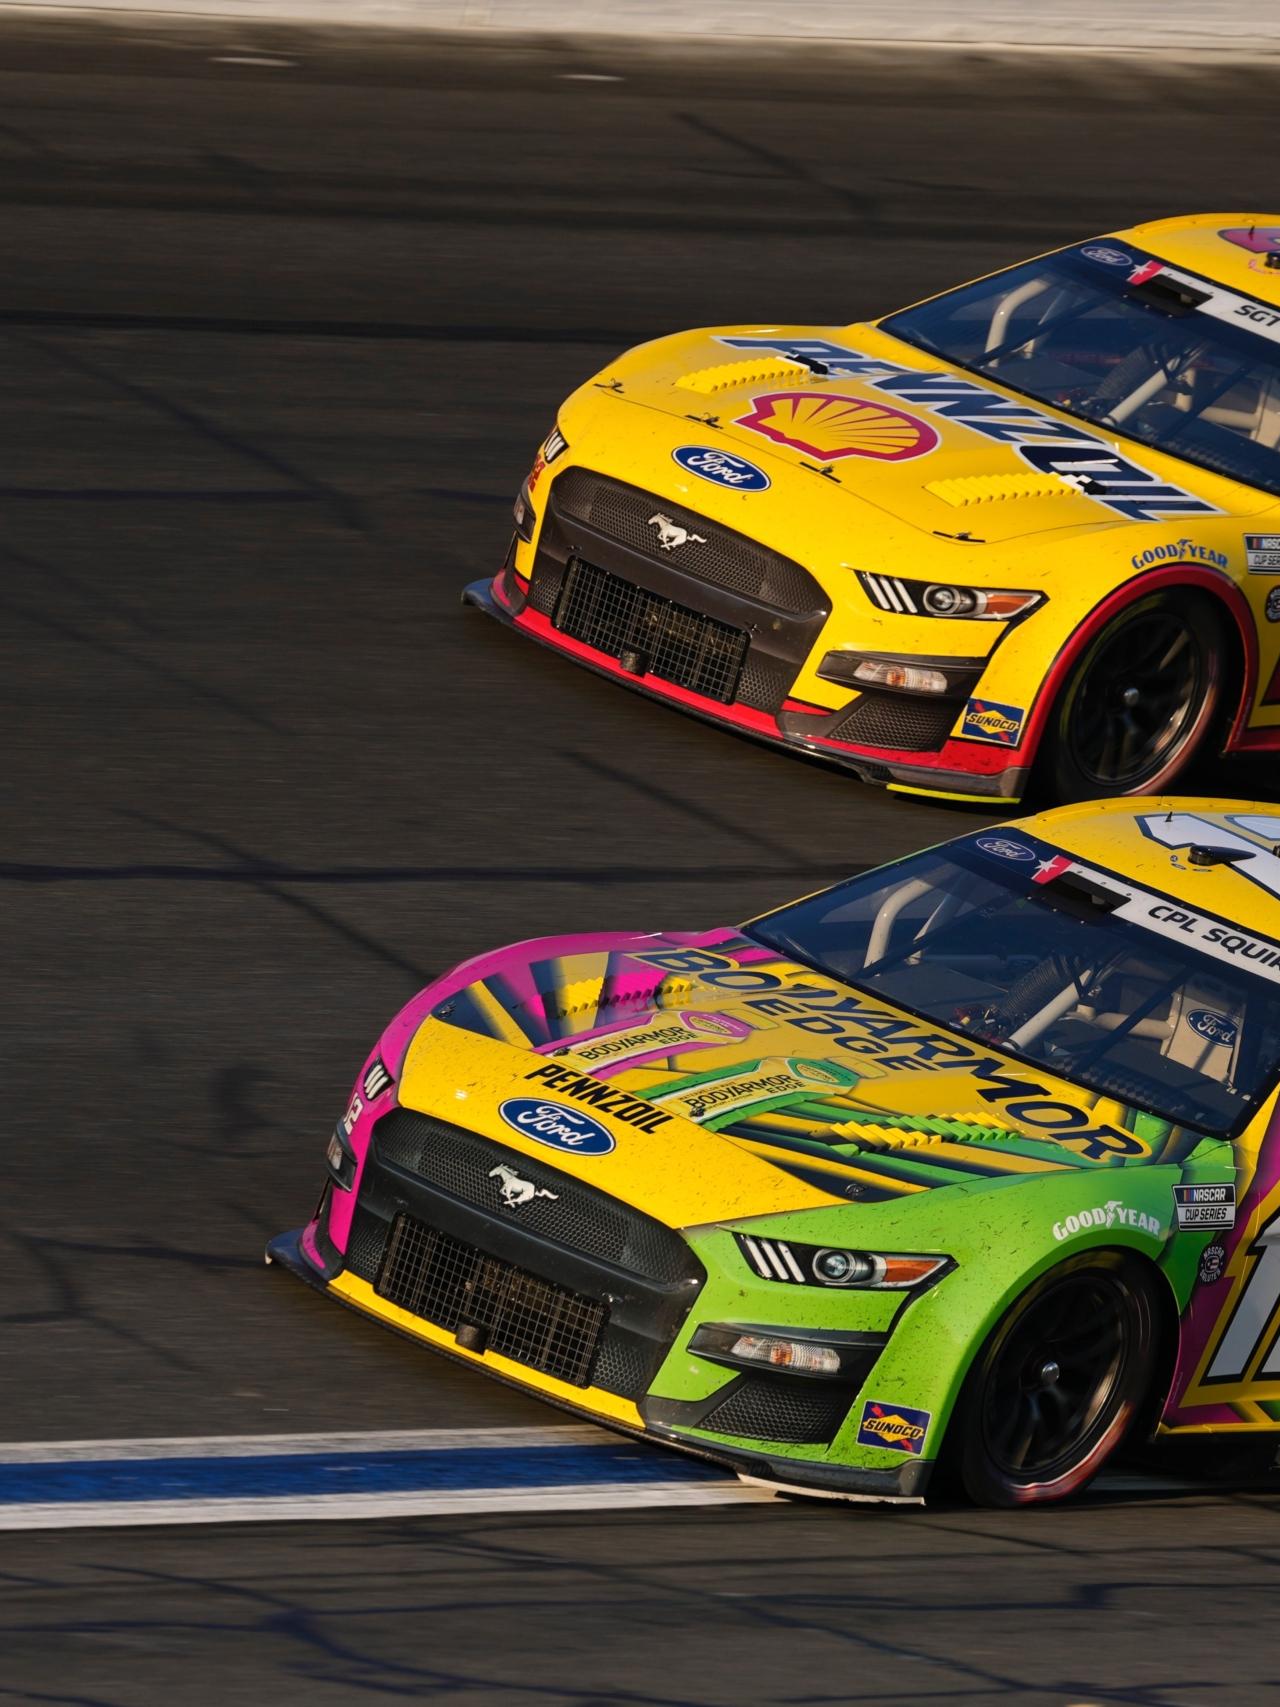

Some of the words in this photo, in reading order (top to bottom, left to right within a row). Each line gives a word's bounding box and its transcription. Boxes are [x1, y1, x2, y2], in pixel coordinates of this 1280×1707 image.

[686, 449, 752, 484] Ford
[1131, 539, 1229, 570] GOODYEAR
[968, 714, 1017, 731] SUNOCO
[985, 838, 1028, 860] Ford
[1147, 905, 1197, 934] CPL
[577, 1026, 687, 1060] BODYARMOR
[659, 1033, 698, 1045] EDGE
[746, 1000, 938, 1071] EDGE
[1196, 1013, 1236, 1043] Ford
[633, 950, 1147, 1160] BODYARMOR
[524, 1063, 677, 1134] PENNZOIL
[684, 1074, 800, 1109] BODYARMOR
[766, 1081, 806, 1094] EDGE
[516, 1106, 594, 1146] Ford
[1193, 1188, 1226, 1202] NASCAR
[1052, 1201, 1161, 1241] GOODYEAR
[1185, 1208, 1199, 1221] CUP
[1199, 1207, 1227, 1220] SERIES
[865, 1419, 922, 1438] SUNOCO
